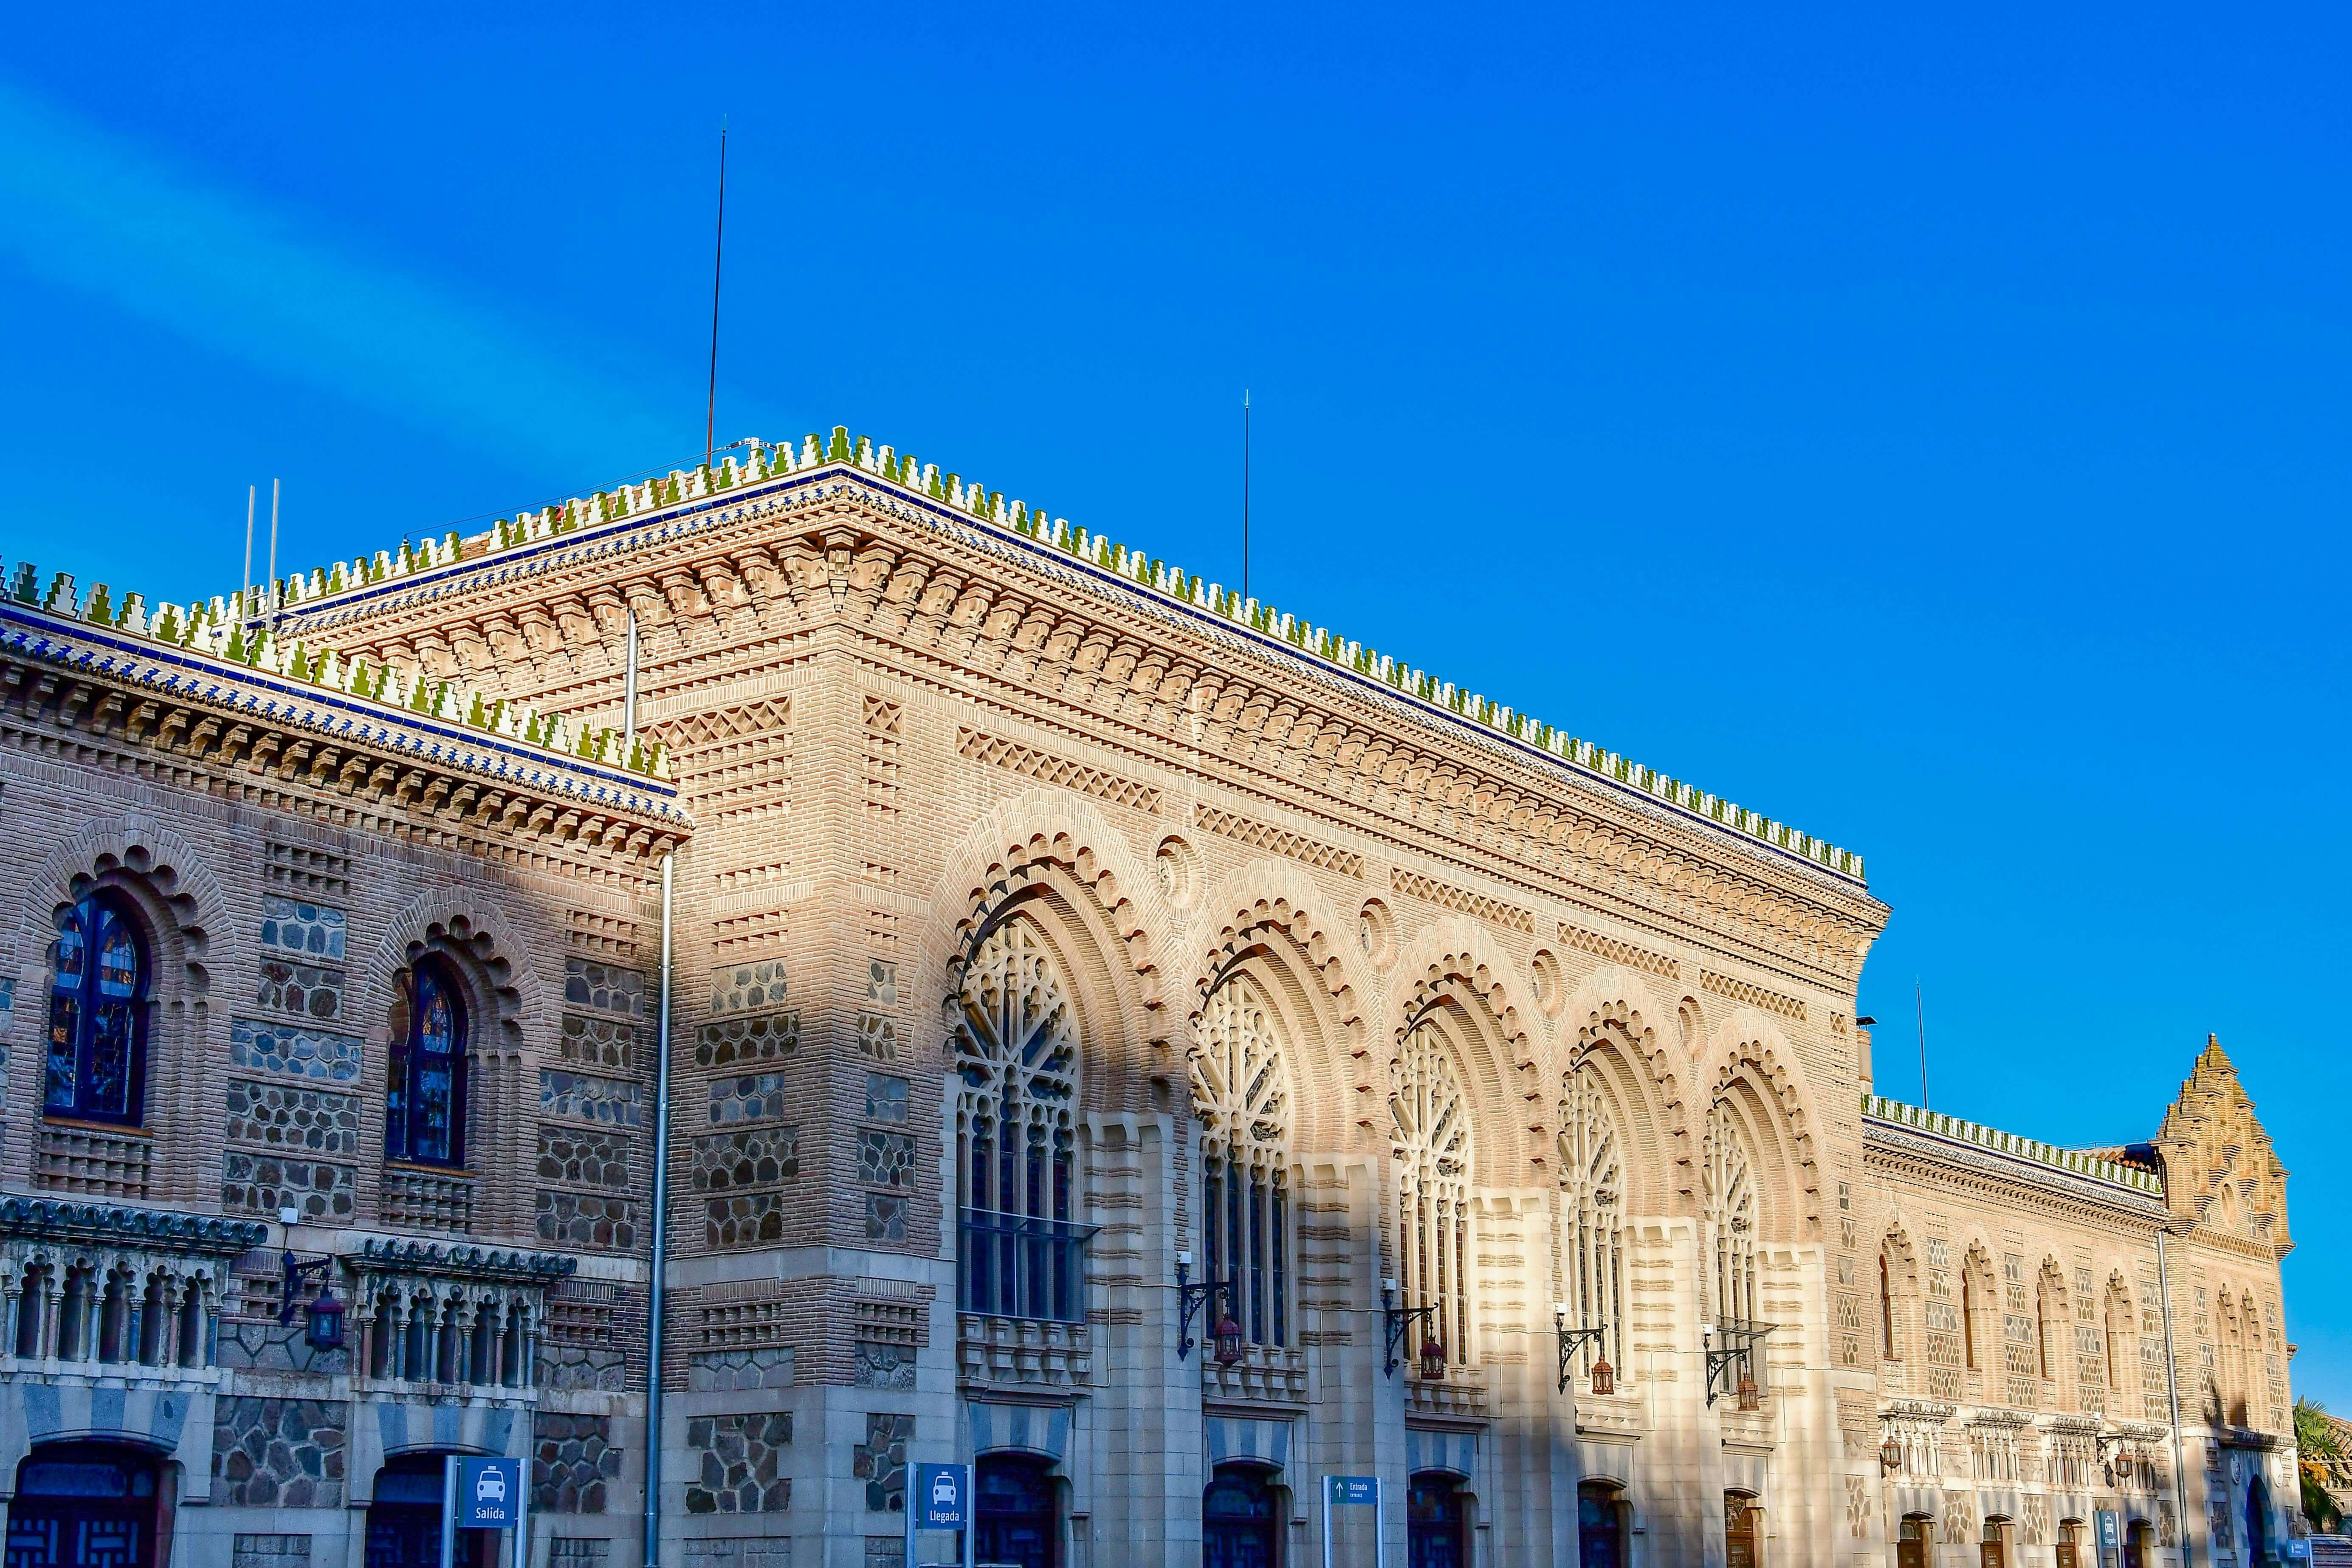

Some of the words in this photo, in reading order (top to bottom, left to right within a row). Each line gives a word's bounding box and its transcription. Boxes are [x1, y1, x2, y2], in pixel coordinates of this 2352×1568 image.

[1350, 1483, 1368, 1491] Entrada
[476, 1506, 505, 1519] Salida
[930, 1510, 959, 1524] Llegada
